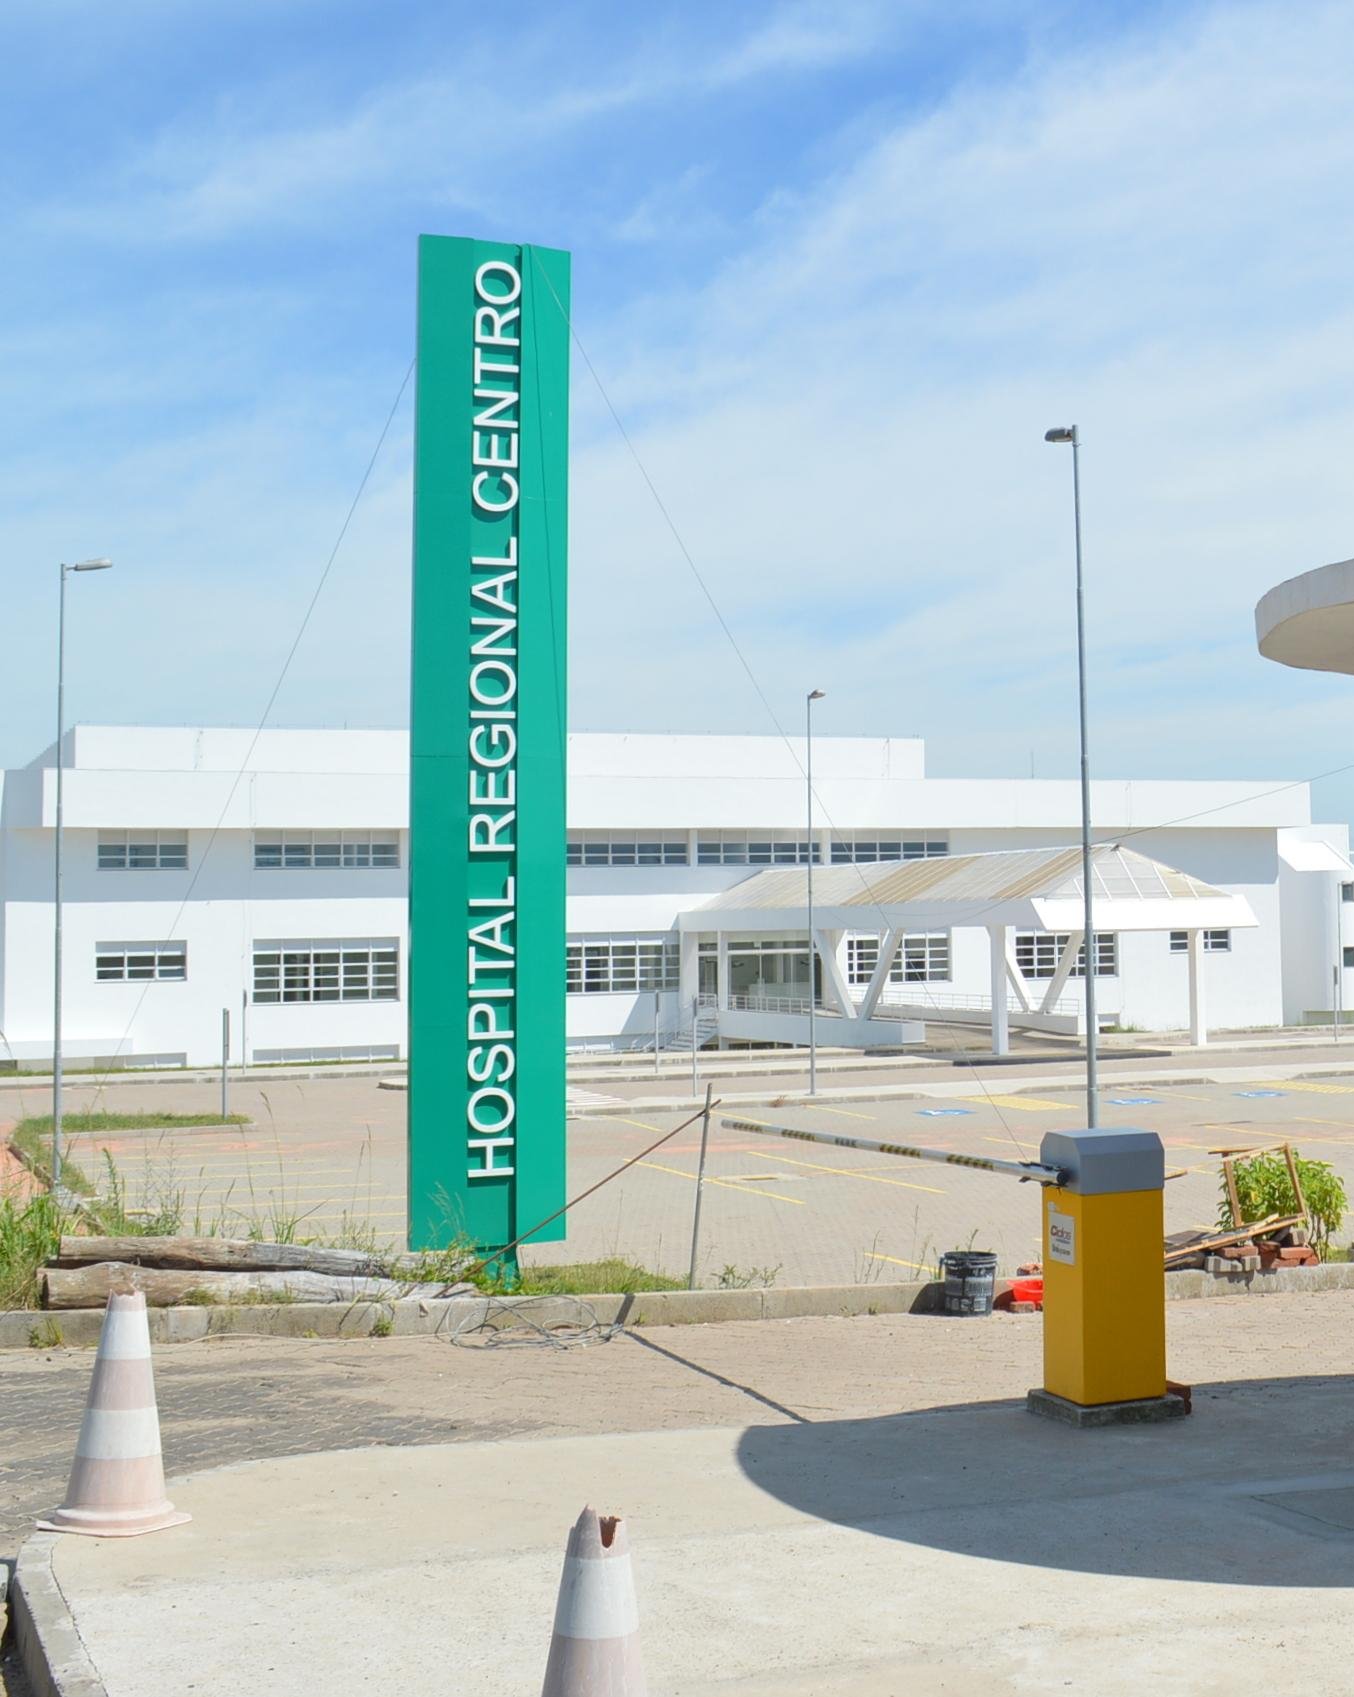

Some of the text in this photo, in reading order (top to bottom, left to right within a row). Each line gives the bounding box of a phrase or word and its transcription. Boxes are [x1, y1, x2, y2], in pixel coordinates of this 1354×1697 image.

[467, 260, 522, 1178] HOSPITAL REGIONAL CENTRO
